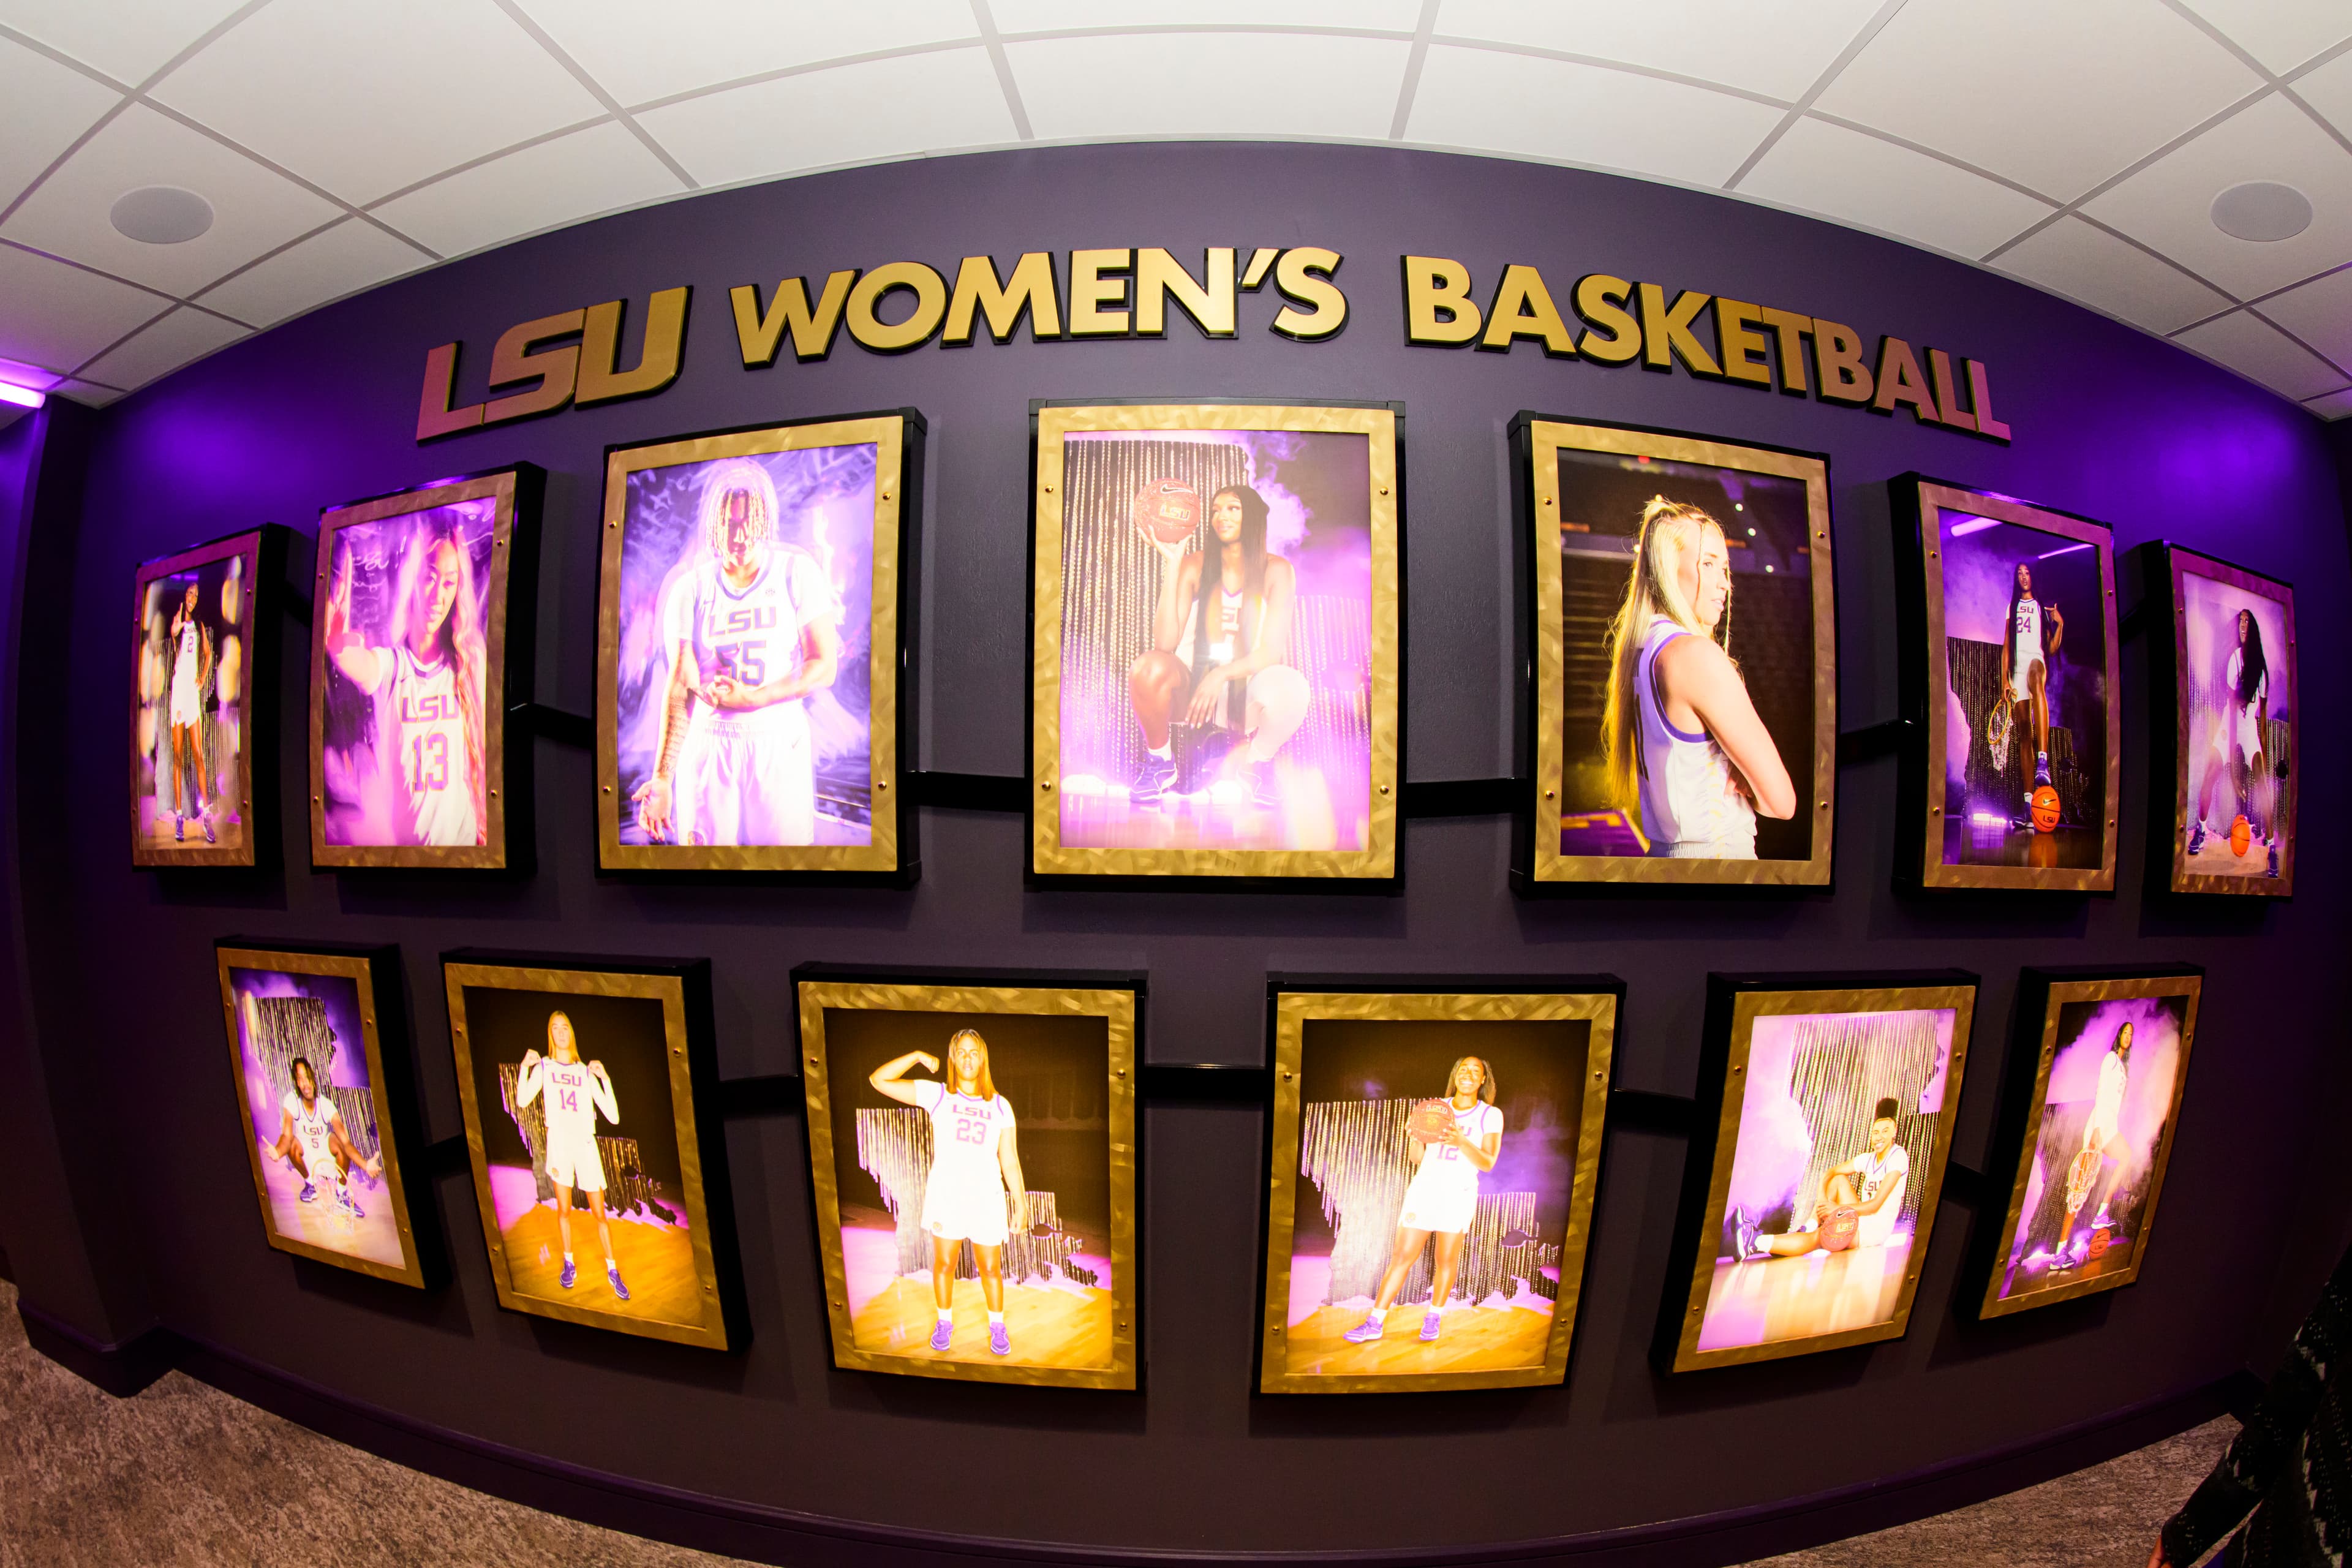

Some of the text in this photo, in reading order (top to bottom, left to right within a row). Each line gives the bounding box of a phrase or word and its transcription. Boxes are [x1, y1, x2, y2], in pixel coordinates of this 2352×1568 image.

[417, 246, 2011, 446] LSU WOMEN'S BASKETBALL
[1159, 503, 1191, 521] LSU
[709, 606, 776, 637] LSU
[2016, 616, 2031, 633] 24
[187, 636, 194, 653] 2
[715, 640, 766, 687] 55
[401, 695, 459, 723] LSU
[412, 733, 449, 792] 13
[2043, 815, 2056, 823] LSU
[551, 1072, 581, 1087] LSU
[559, 1088, 578, 1112] 14
[952, 1104, 992, 1120] LSU
[303, 1125, 323, 1136] LSU
[956, 1118, 987, 1145] 23
[311, 1137, 319, 1149] 5
[1437, 1144, 1460, 1161] 12
